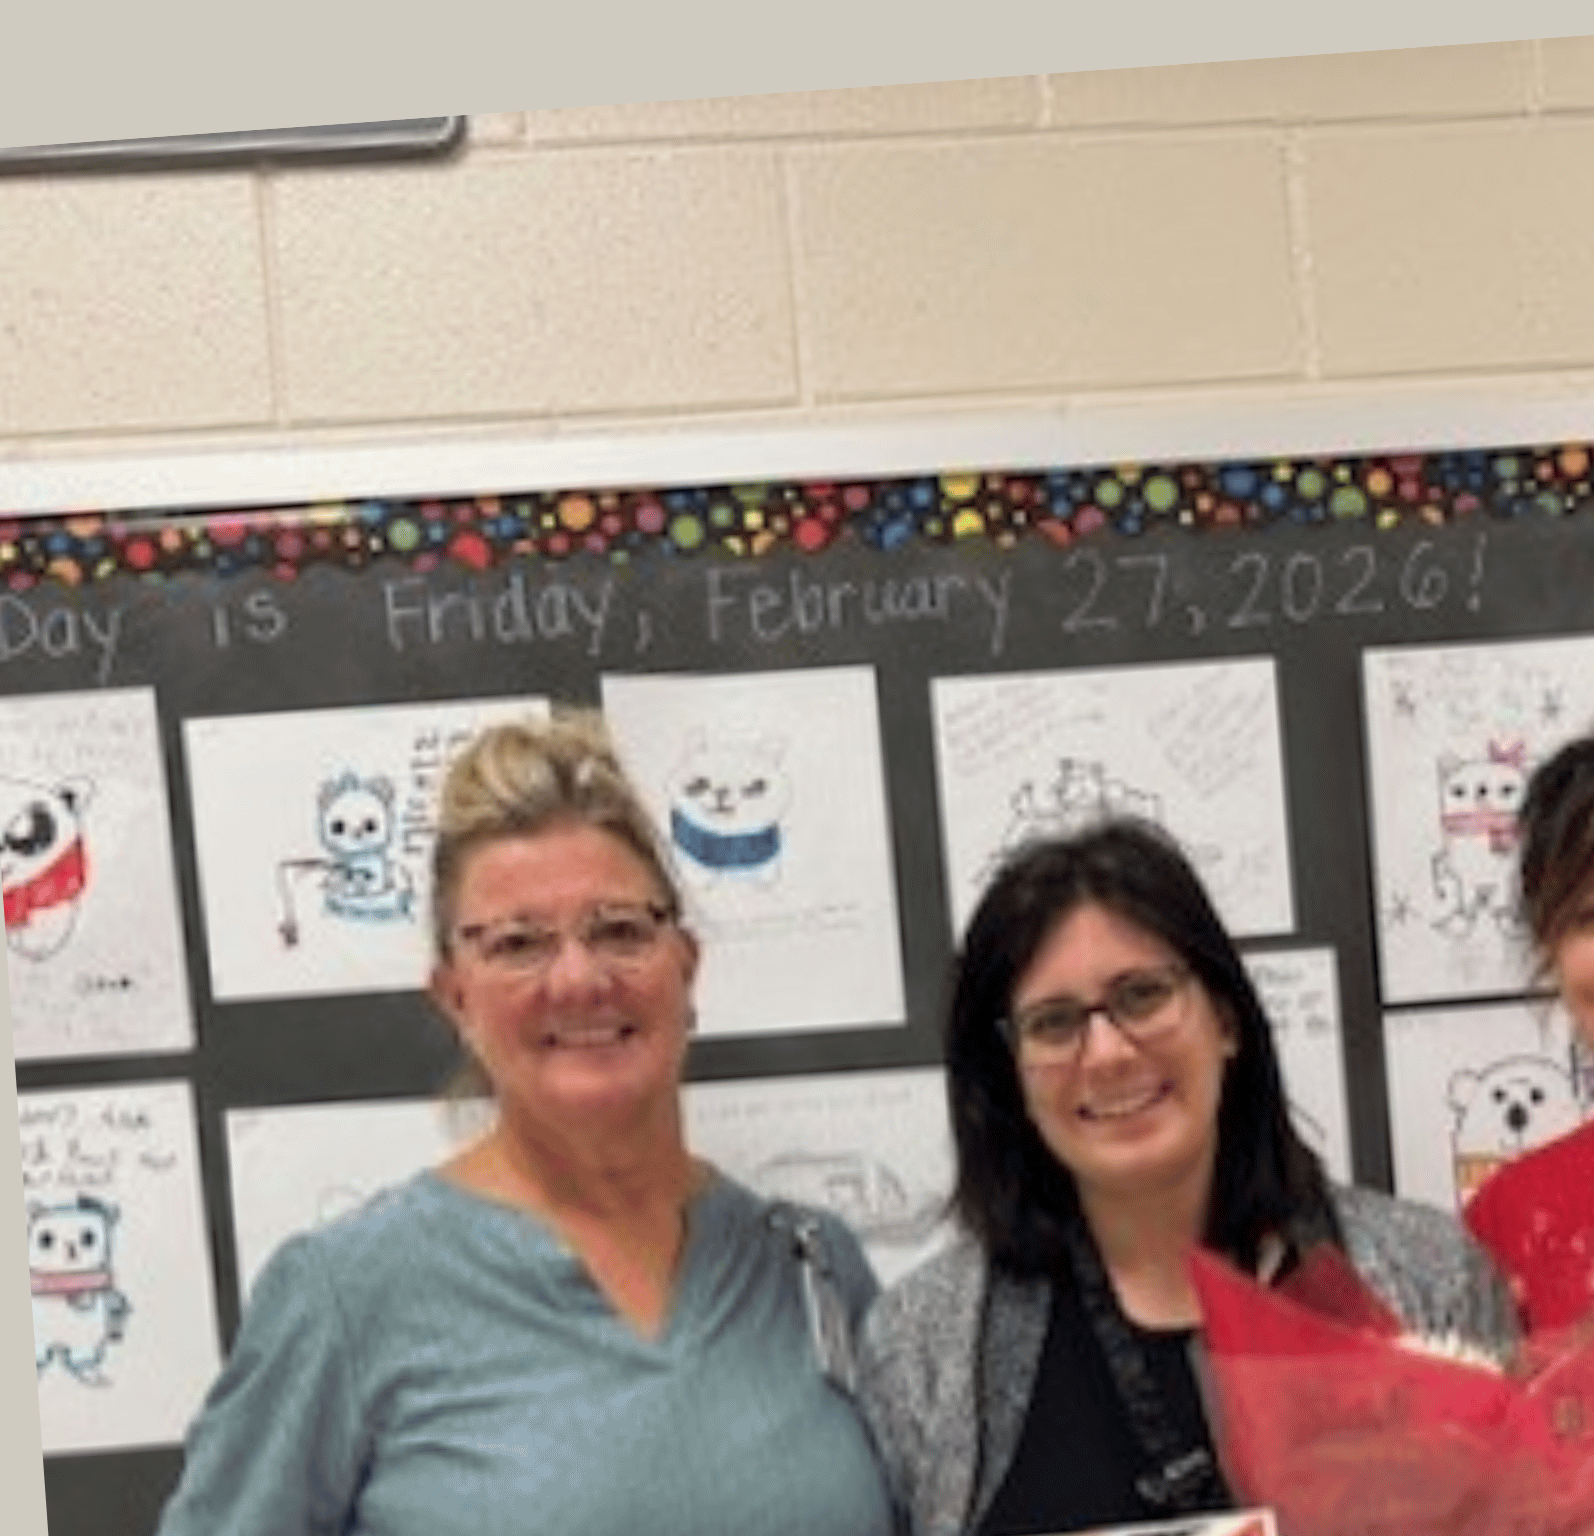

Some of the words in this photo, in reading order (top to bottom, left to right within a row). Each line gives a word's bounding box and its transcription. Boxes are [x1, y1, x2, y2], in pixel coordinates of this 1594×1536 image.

[216, 588, 288, 648] is
[383, 574, 652, 655] Friday,
[704, 563, 1011, 655] February
